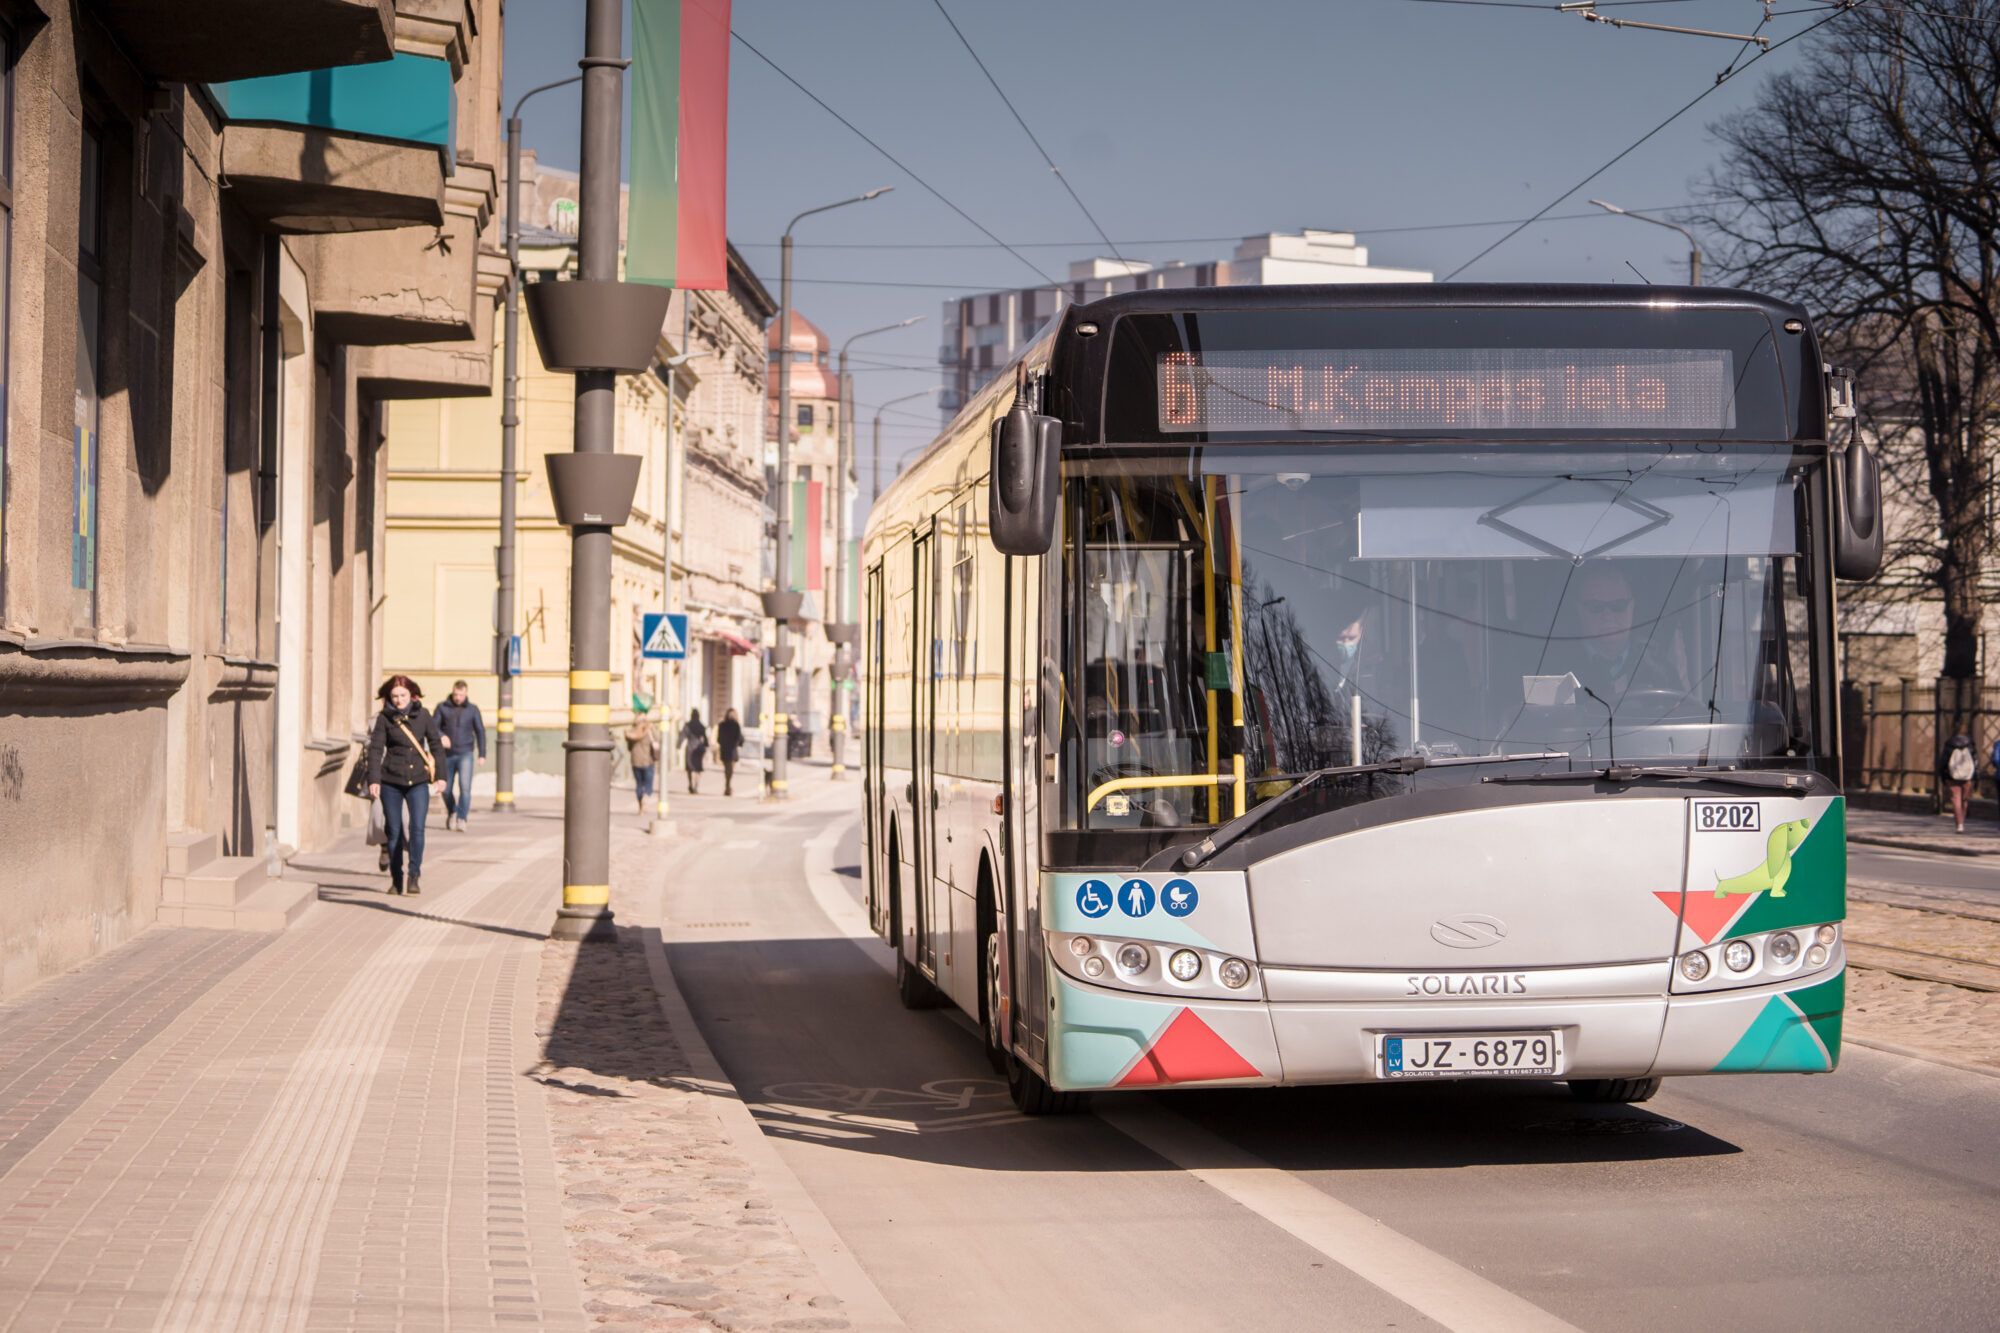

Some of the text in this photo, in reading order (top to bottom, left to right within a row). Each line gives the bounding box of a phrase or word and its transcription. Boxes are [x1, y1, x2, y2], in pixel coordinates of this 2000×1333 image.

[1166, 353, 1196, 424] 6
[1565, 363, 1668, 411] iela
[1702, 805, 1754, 828] 8202
[1407, 975, 1527, 995] SOLARIS
[1389, 1058, 1401, 1067] LV
